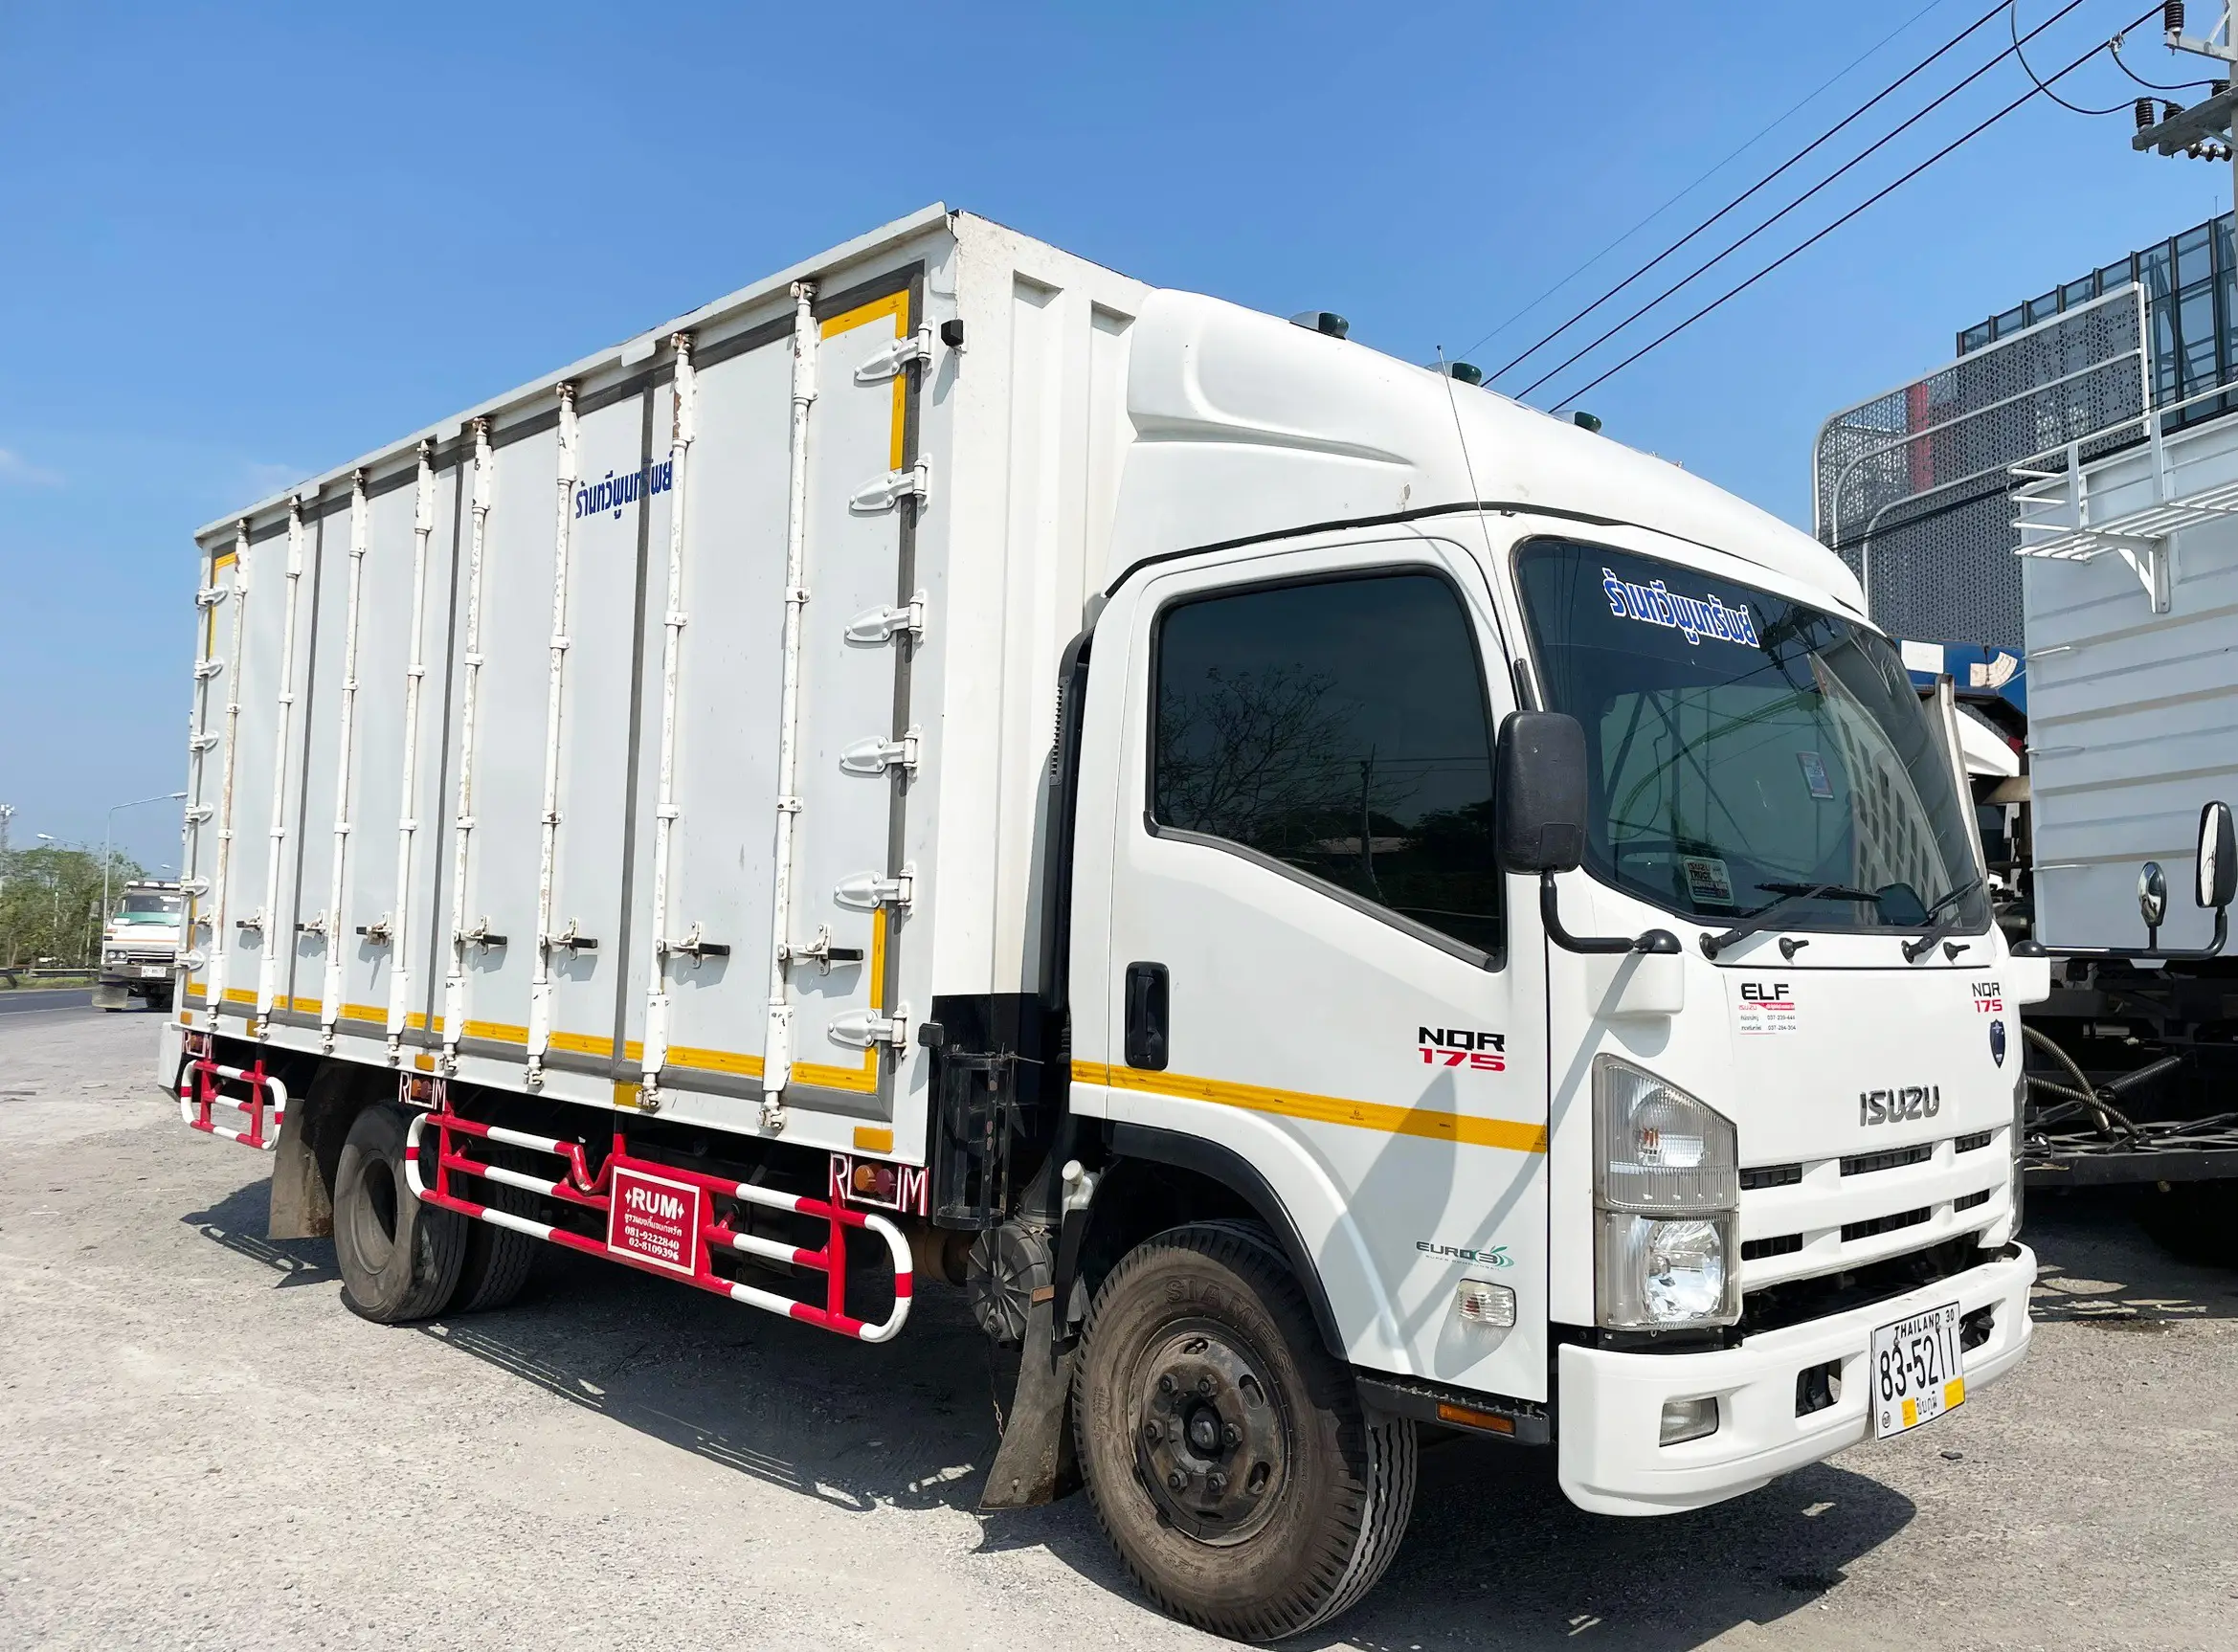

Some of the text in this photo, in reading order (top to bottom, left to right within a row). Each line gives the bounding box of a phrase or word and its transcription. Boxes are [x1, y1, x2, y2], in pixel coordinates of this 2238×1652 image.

[1741, 983, 1789, 1000] ELF
[1972, 982, 2001, 997] NQR
[1975, 999, 2003, 1013] 175
[1419, 1026, 1506, 1052] NQR
[1419, 1048, 1506, 1072] 175
[1859, 1083, 1940, 1127] ISUZU
[632, 1186, 679, 1220] RUM
[1894, 1312, 1940, 1339] THAILAND
